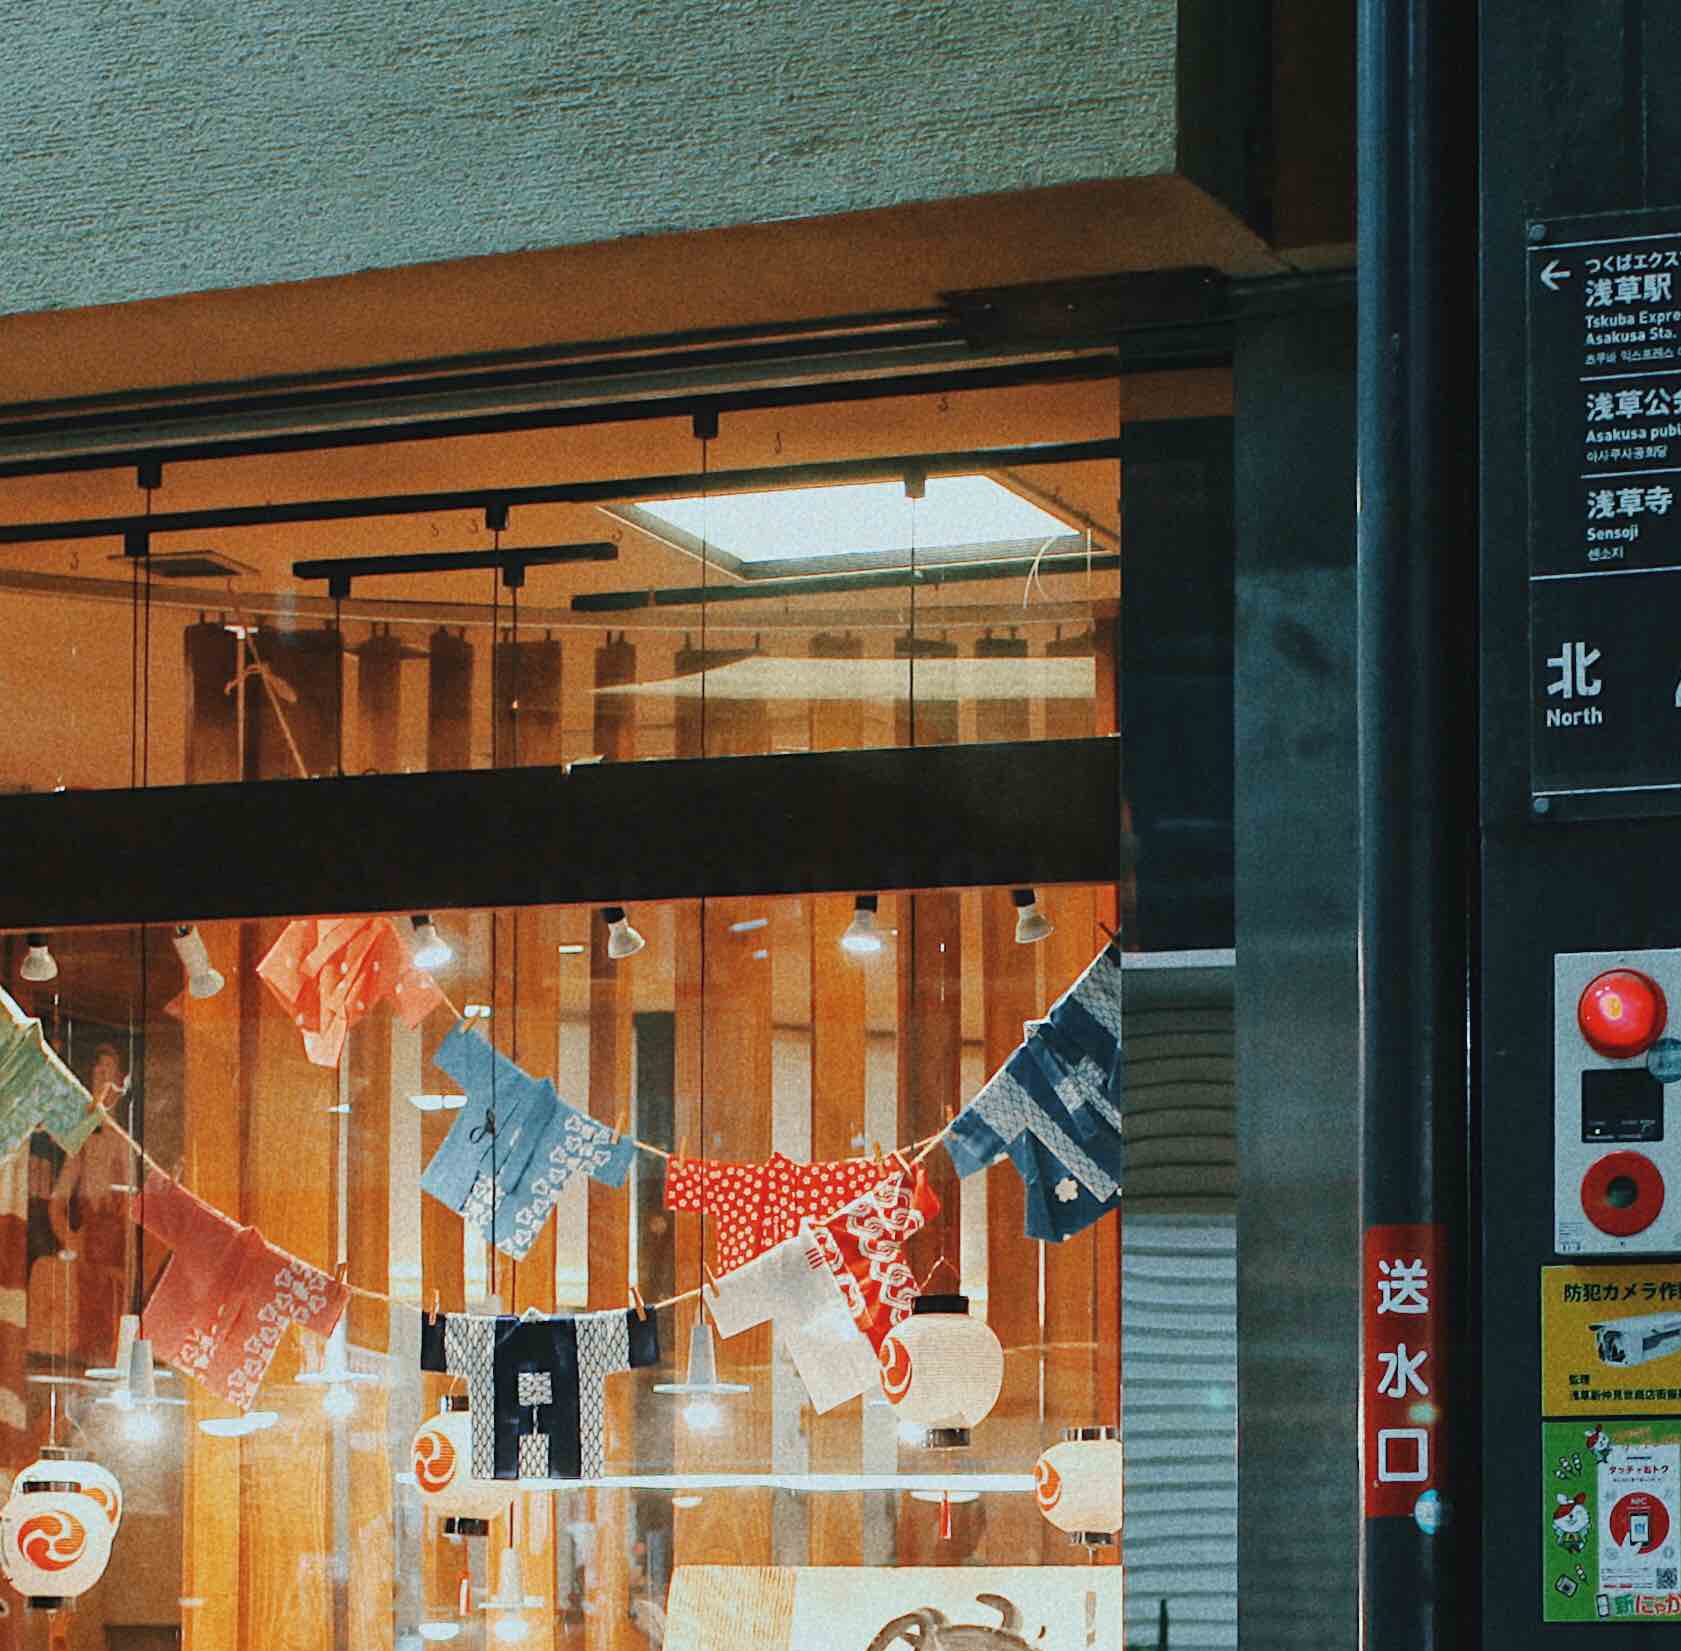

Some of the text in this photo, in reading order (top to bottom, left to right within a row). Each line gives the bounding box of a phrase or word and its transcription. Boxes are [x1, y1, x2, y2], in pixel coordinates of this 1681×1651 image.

[1585, 273, 1672, 307] 浅草駅
[1585, 327, 1677, 346] Asakusa Sta.
[1585, 428, 1647, 444] Asakusa
[1587, 485, 1673, 519] 浅草寺
[1587, 524, 1639, 541] Sensoji
[1546, 642, 1602, 699] 北
[1546, 706, 1604, 728] North
[1377, 1257, 1430, 1483] 送水口
